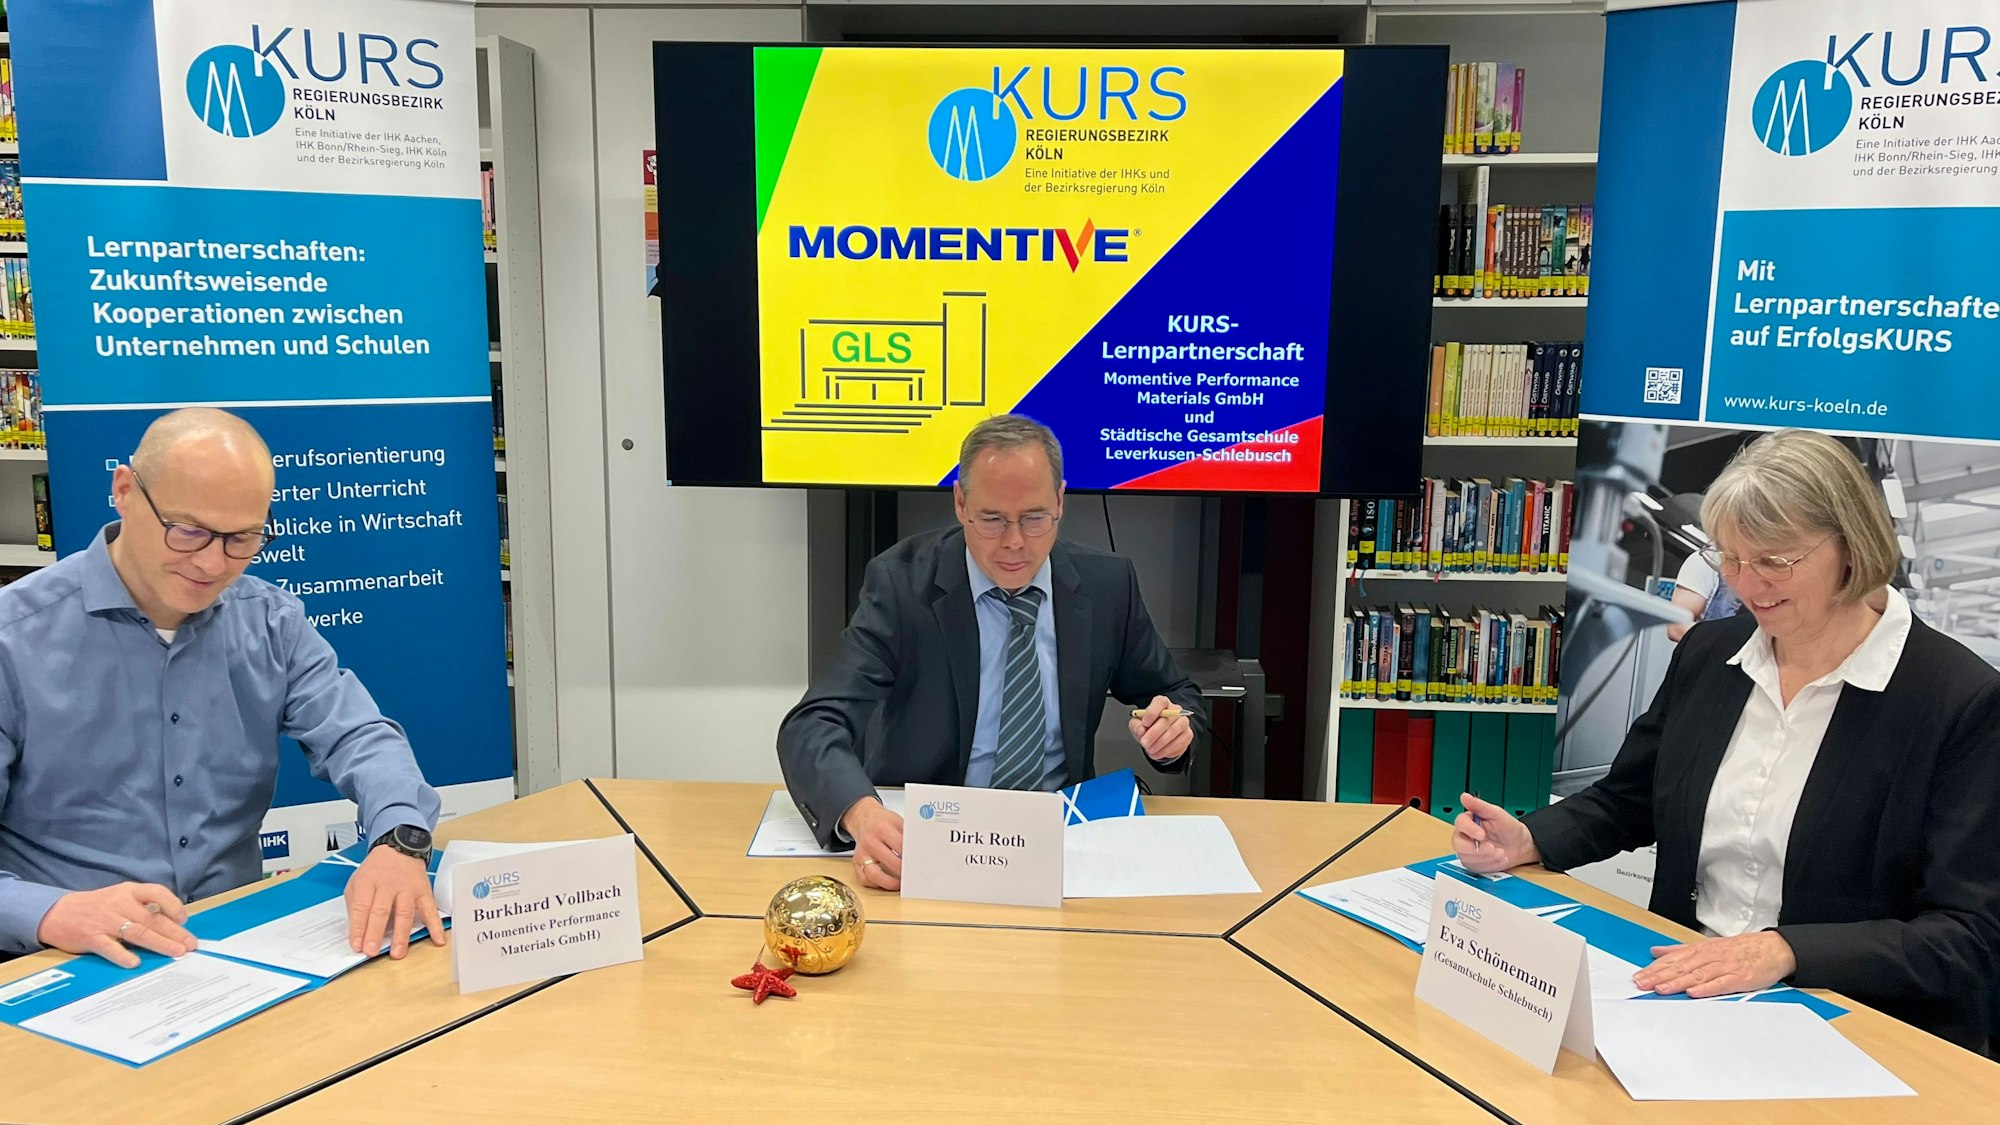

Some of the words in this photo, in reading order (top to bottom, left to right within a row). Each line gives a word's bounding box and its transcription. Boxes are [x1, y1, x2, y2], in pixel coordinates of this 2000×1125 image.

[252, 24, 444, 89] KURS
[1824, 26, 2000, 90] KUR
[293, 88, 443, 110] REGIERUNGSBEZIRK
[993, 66, 1186, 121] KURS
[294, 105, 335, 121] KÖLN
[1858, 114, 1904, 130] KÖLN
[295, 128, 316, 139] Eine
[319, 129, 361, 141] Initiative
[364, 132, 381, 141] der
[384, 132, 401, 142] IHK
[404, 134, 441, 145] Aachen,
[1026, 129, 1169, 142] REGIERUNGSBEZIRK
[1856, 139, 1879, 148] Eine
[1883, 137, 1930, 148] Initiative
[1934, 136, 1952, 147] der
[1956, 136, 1978, 145] IHK
[296, 141, 314, 151] IHK
[317, 141, 403, 157] Bonn/Rhein-Sieg,
[406, 146, 423, 156] IHK
[426, 147, 447, 157] Köln
[1026, 145, 1063, 161] KÖLN
[1854, 152, 1875, 162] IHK
[1878, 150, 1977, 162] Bonn/Rhein-Sieg,
[1981, 149, 2000, 159] IHK
[297, 153, 315, 163] und
[318, 154, 335, 164] der
[339, 155, 421, 169] Bezirksregierung
[424, 158, 445, 169] Köln
[1853, 167, 1874, 176] und
[1877, 166, 1895, 176] der
[1899, 164, 1997, 176] Bezirksregierung
[1026, 168, 1047, 178] Eine
[1051, 168, 1096, 179] Initiative
[1100, 168, 1117, 178] der
[1121, 168, 1146, 179] IHKs
[1150, 168, 1170, 178] und
[1025, 182, 1041, 192] der
[1046, 182, 1137, 195] Bezirksregierung
[1141, 182, 1165, 193] Köln
[87, 236, 365, 262] Lernpartnerschaften:
[1737, 260, 1775, 281] Mit
[89, 270, 327, 293] Zukunftsweisende
[93, 304, 284, 327] Kooperationen
[292, 305, 403, 324] zwischen
[1168, 315, 1239, 333] KURS-
[95, 336, 275, 357] Unternehmen
[283, 335, 327, 355] und
[335, 335, 429, 355] Schulen
[832, 331, 912, 363] GLS
[1731, 326, 1770, 346] auf
[1777, 326, 1952, 354] ErfolgsKURS
[1102, 341, 1304, 364] Lernpartnerschaft
[1104, 372, 1191, 388] Momentive
[1197, 372, 1299, 388] Performance
[1138, 391, 1210, 405] Materials
[1215, 391, 1264, 405] GmbH
[1725, 396, 1888, 416] www.kurs-koeln.de
[1185, 410, 1214, 424] und
[1100, 428, 1181, 443] Städtische
[1187, 429, 1298, 445] Gesamtschule
[272, 447, 445, 468] erufsorientierung
[1106, 447, 1292, 462] Leverkusen-Schlebusch
[271, 485, 321, 502] erter
[327, 478, 427, 500] Unterricht
[262, 516, 332, 536] nblicke
[340, 516, 356, 532] in
[361, 509, 462, 530] Wirtschaft
[1542, 506, 1551, 534] TITANIC
[252, 545, 305, 564] swelt
[276, 569, 443, 595] Zusammenarbeit
[308, 608, 363, 628] werke
[930, 801, 960, 811] KURS
[263, 834, 287, 848] IHK
[950, 829, 985, 846] Dirk
[990, 832, 1026, 848] Roth
[965, 855, 1008, 868] (KURS)
[484, 872, 519, 887] KURS
[474, 897, 549, 922] Burkhard
[555, 885, 621, 907] Vollbach
[1455, 898, 1481, 919] KURS
[477, 922, 546, 944] (Momentive
[549, 909, 620, 930] Performance
[500, 940, 555, 956] Materials
[559, 930, 600, 946] GmbH)
[1439, 925, 1464, 950] Eva
[1468, 939, 1558, 999] Schönemann
[1434, 950, 1496, 991] (Gesamtschule
[1498, 983, 1553, 1023] Schlebusch)
